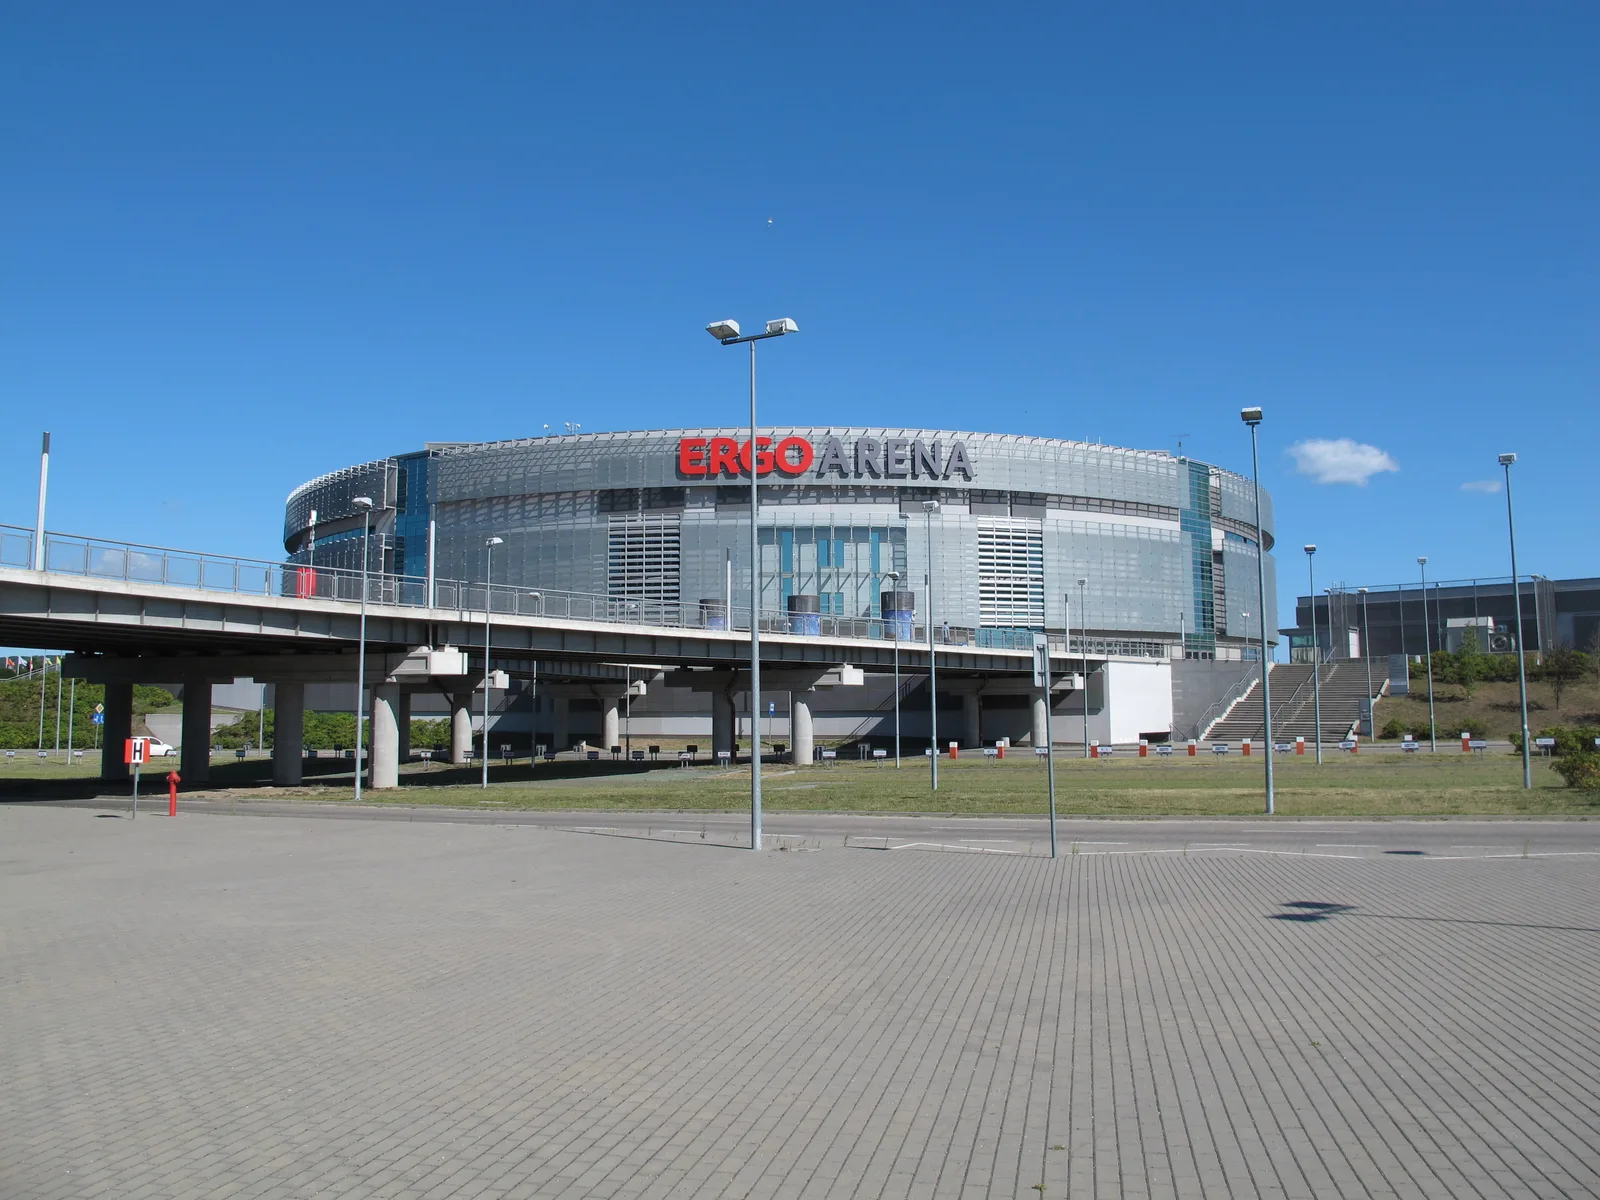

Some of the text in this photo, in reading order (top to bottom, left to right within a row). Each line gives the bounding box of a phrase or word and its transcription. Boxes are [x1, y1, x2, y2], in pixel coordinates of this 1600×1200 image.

[679, 436, 975, 477] ERGO ARENA
[132, 742, 143, 761] H
